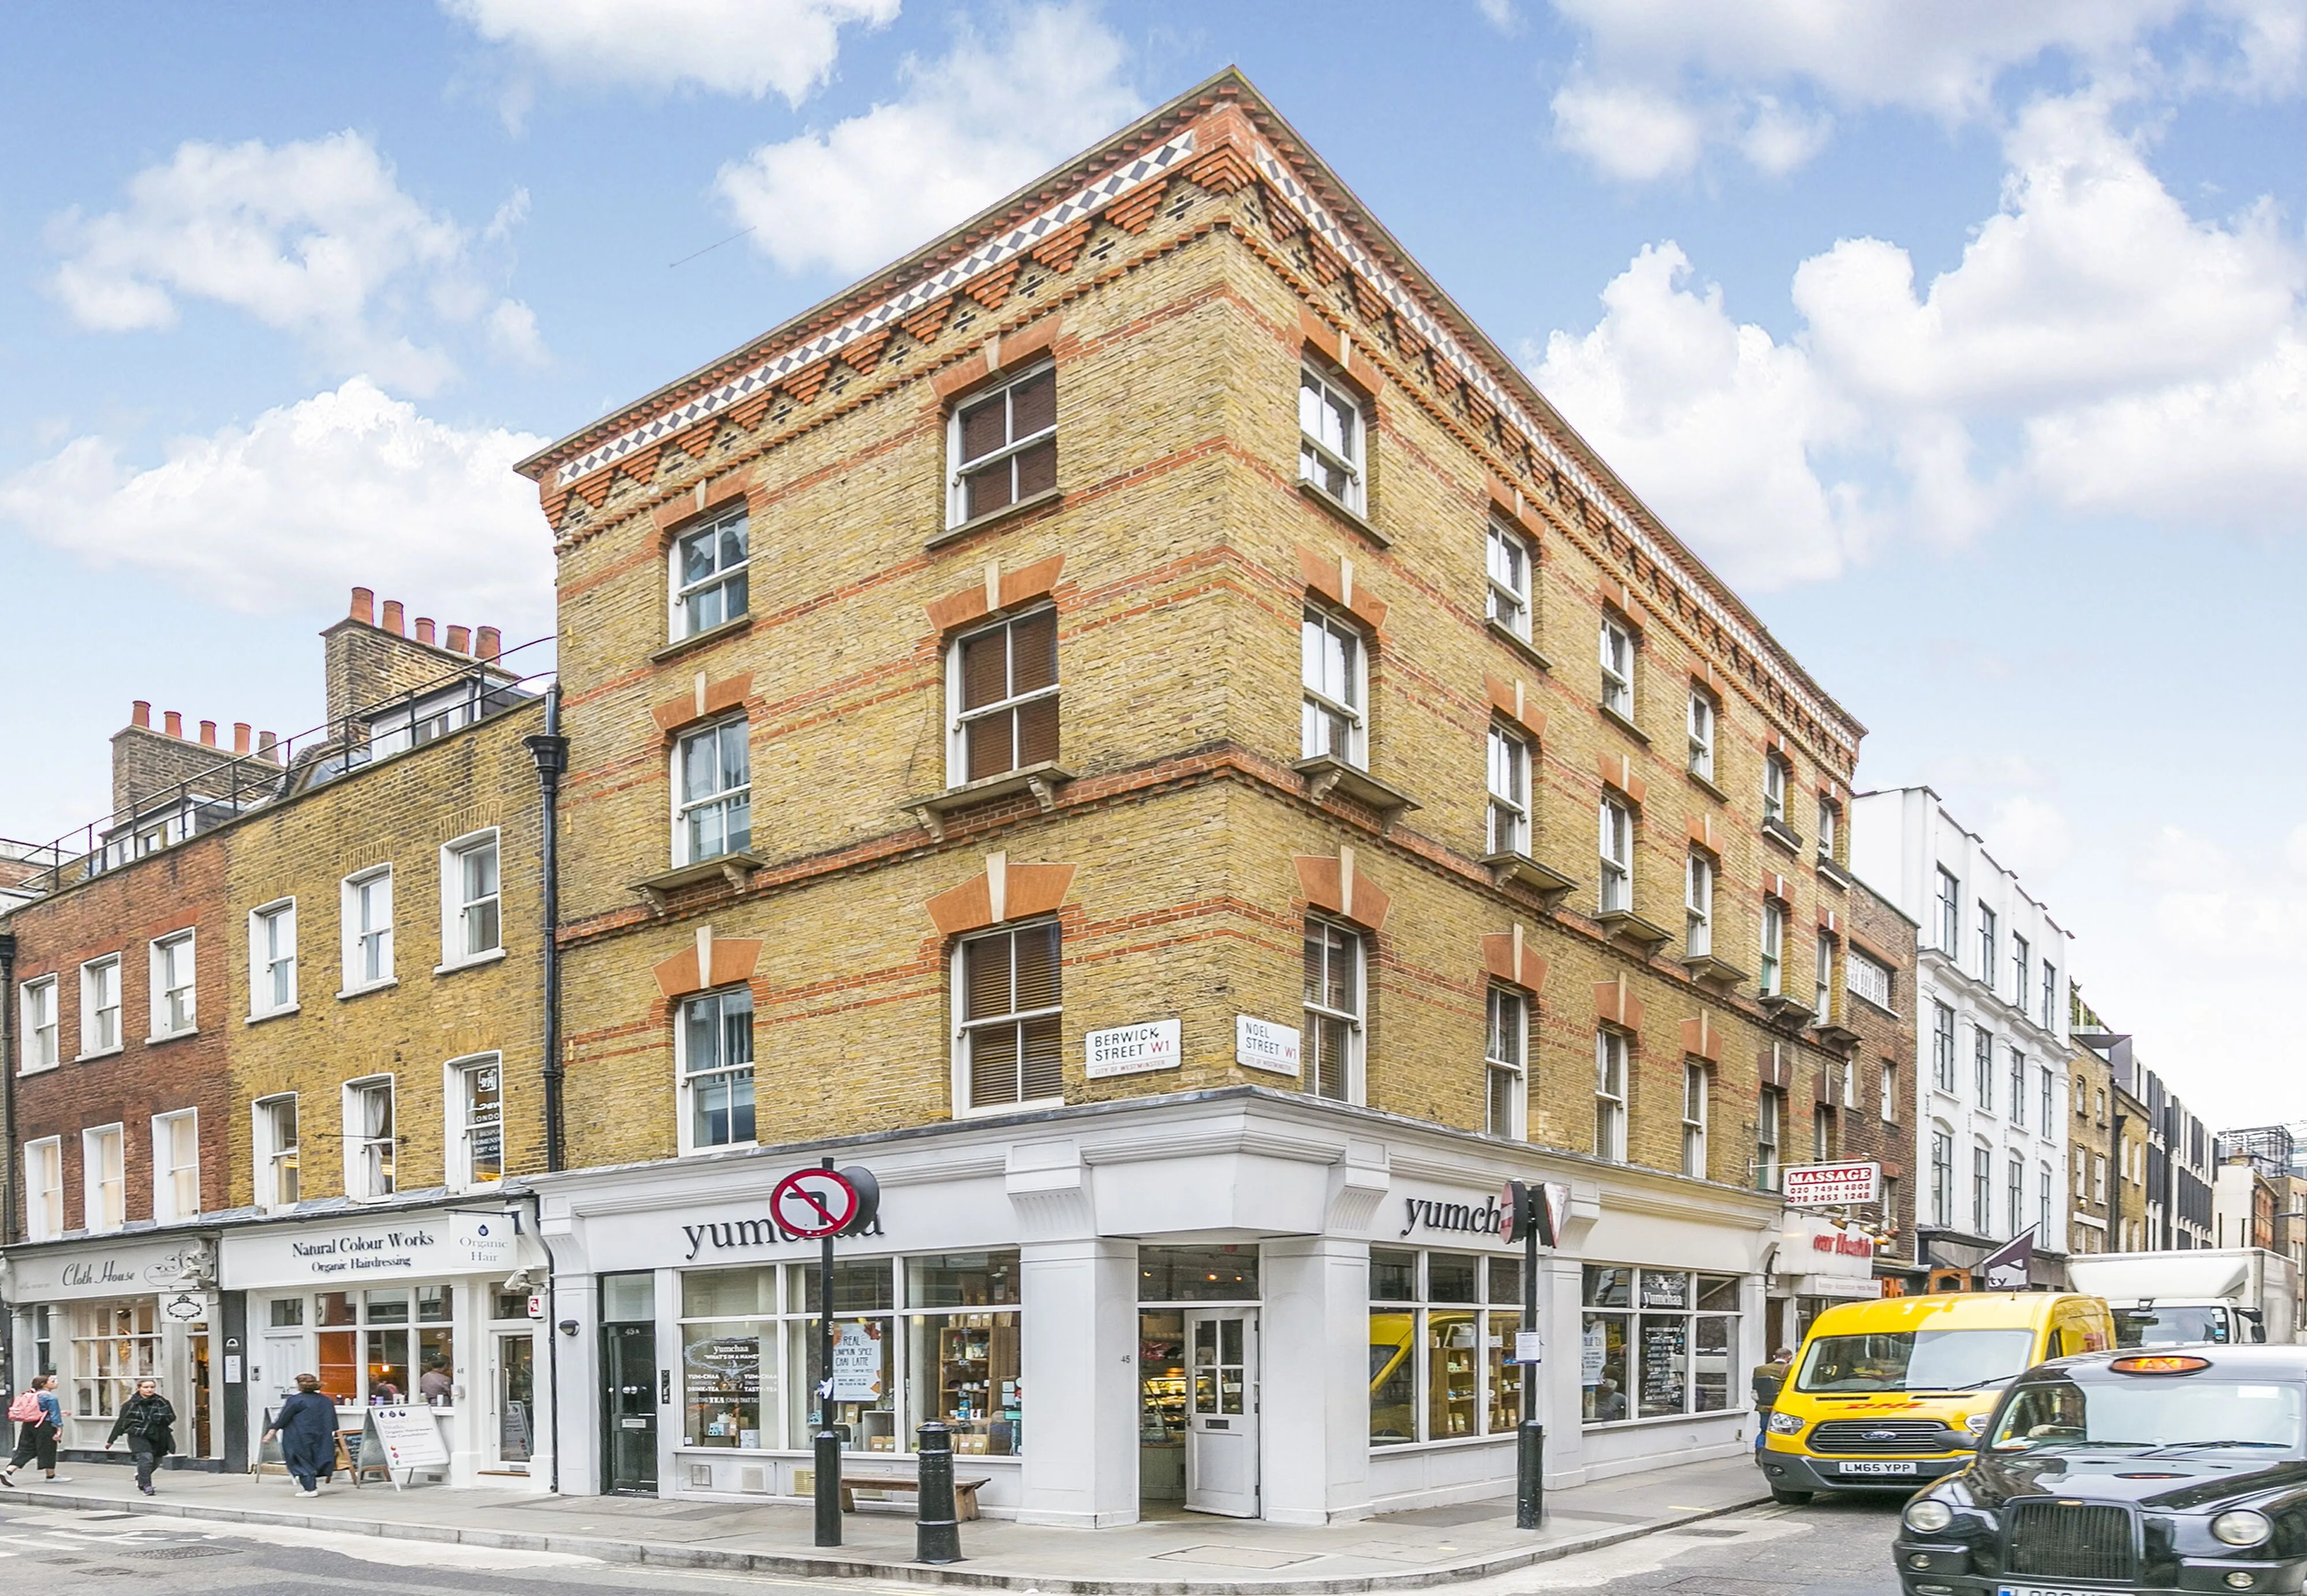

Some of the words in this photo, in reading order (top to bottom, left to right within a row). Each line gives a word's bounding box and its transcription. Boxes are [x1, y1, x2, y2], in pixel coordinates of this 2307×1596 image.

[1246, 1022, 1270, 1038] NOEL
[1095, 1027, 1159, 1047] BERWICK
[1095, 1044, 1144, 1061] STREET
[1151, 1041, 1170, 1053] W1
[1246, 1037, 1279, 1055] STREET
[1285, 1046, 1297, 1060] W1
[1120, 1060, 1166, 1071] WESTMINSTER
[1790, 1169, 1871, 1184] MASSAGE
[293, 1239, 336, 1257] Natural
[339, 1236, 384, 1253] Colour
[388, 1231, 434, 1248] Works
[460, 1236, 509, 1249] Organic
[471, 1251, 499, 1262] Hair
[312, 1259, 347, 1273] Organic
[351, 1255, 411, 1269] Hairdressing
[62, 1262, 92, 1286] Cloth
[94, 1259, 135, 1283] House
[843, 1336, 861, 1346] REAL
[858, 1347, 872, 1355] SPICE
[835, 1357, 849, 1366] CHAI
[852, 1357, 869, 1366] LATTE
[1121, 1355, 1130, 1363] 45
[2130, 1359, 2185, 1370] TAXI
[1845, 1463, 1881, 1472] LM65
[1884, 1463, 1910, 1472] YPP
